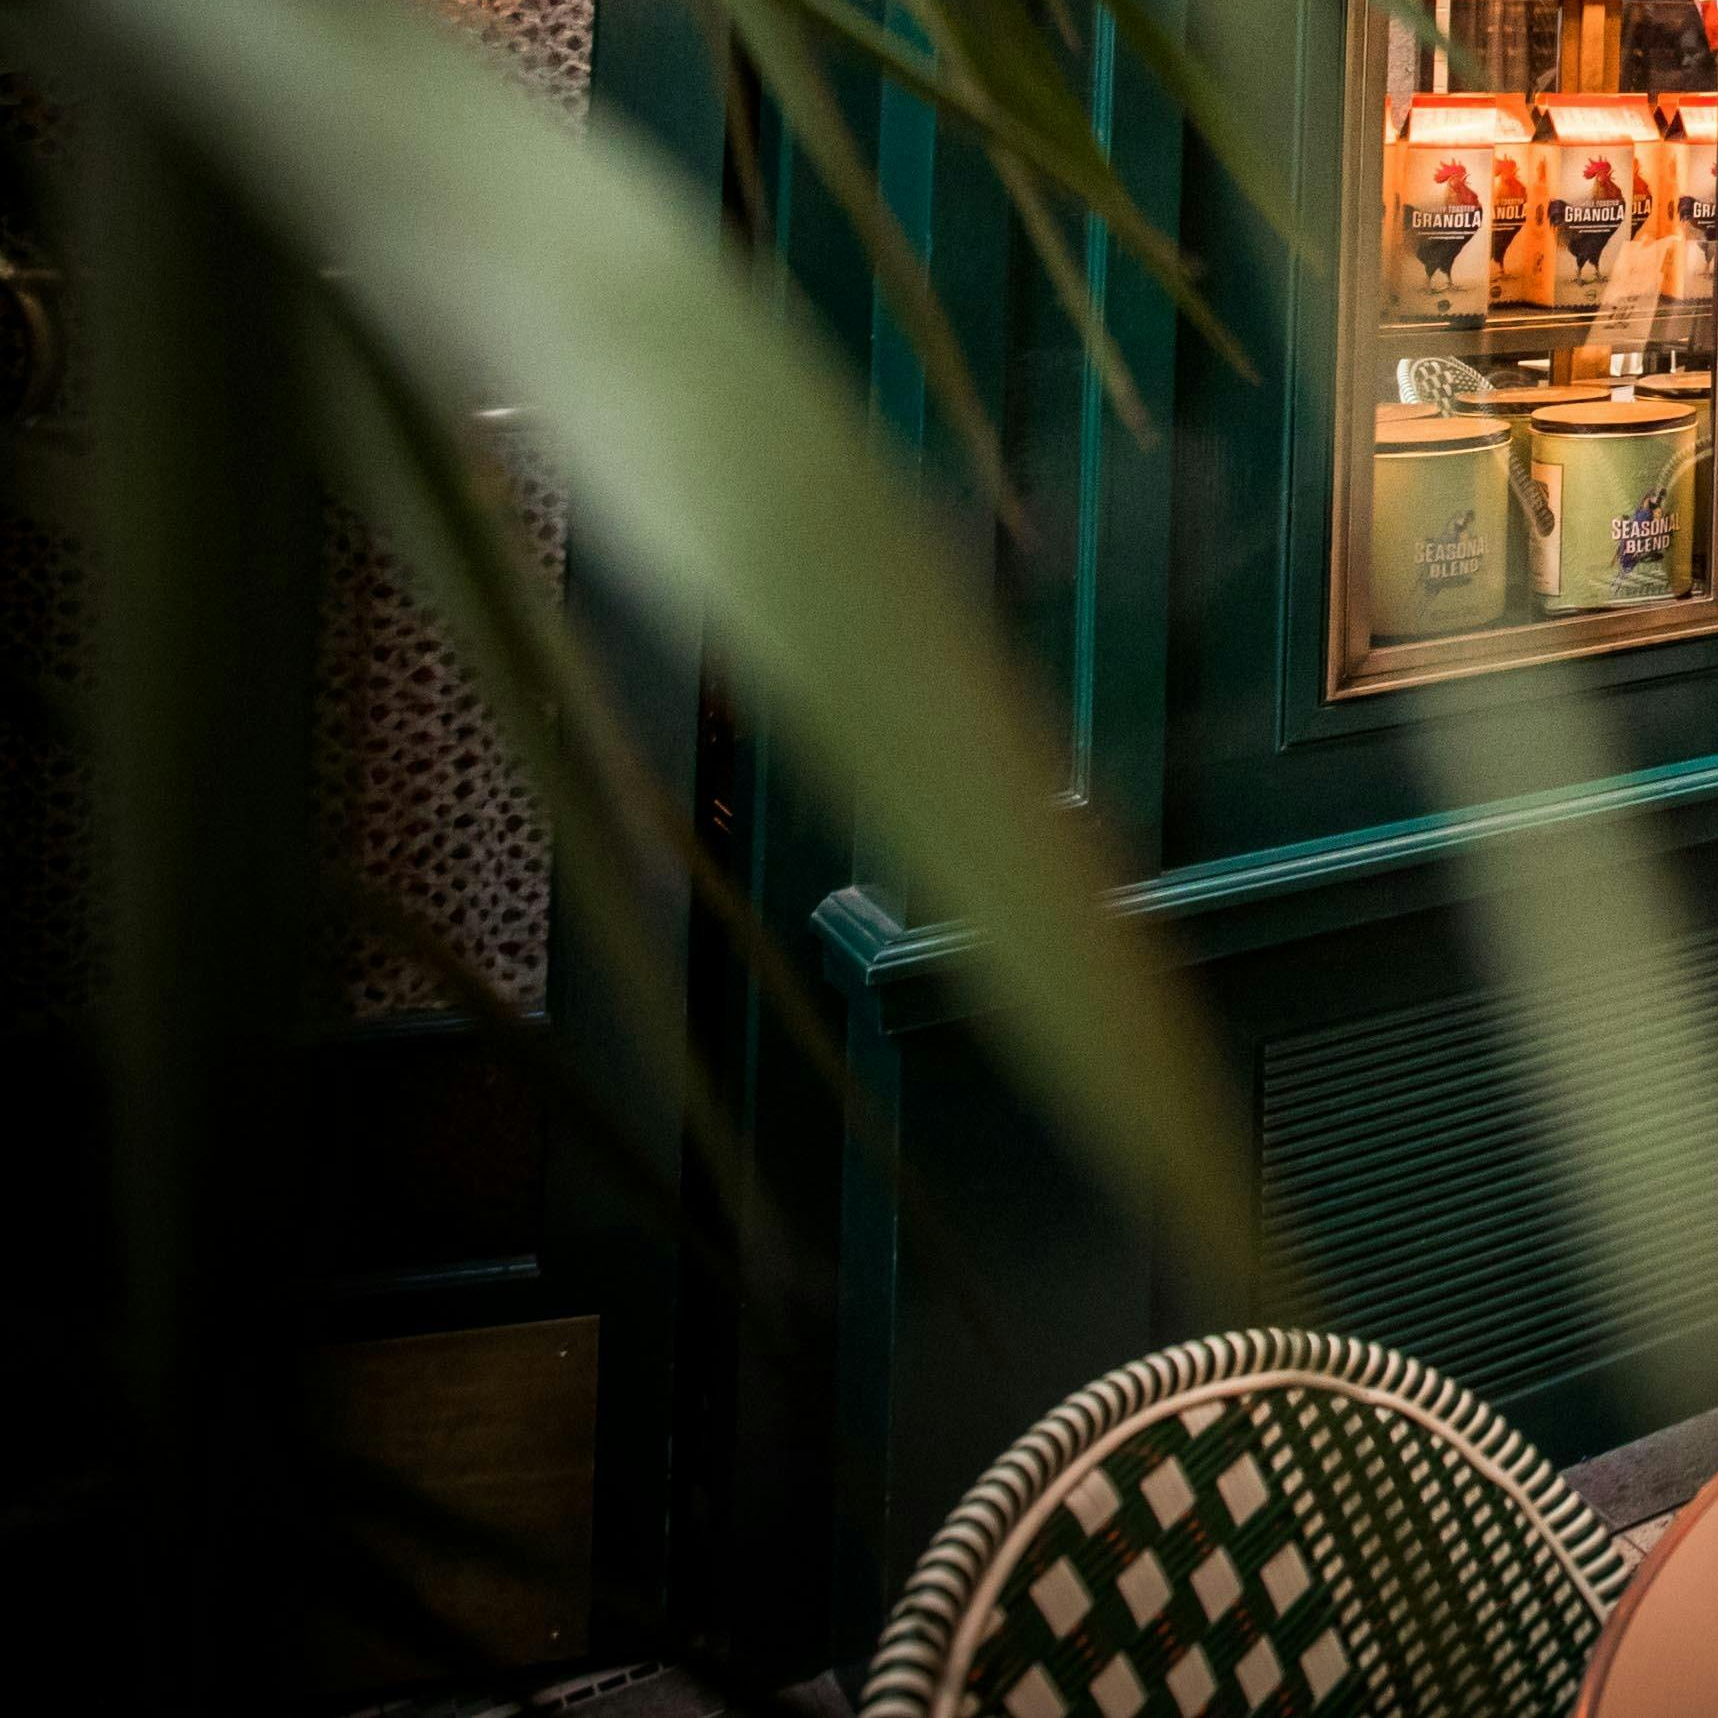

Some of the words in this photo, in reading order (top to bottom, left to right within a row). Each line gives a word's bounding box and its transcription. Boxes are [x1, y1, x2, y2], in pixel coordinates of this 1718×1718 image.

[1412, 210, 1481, 228] GRANOLA
[1564, 204, 1625, 223] GRANOLA
[1611, 512, 1682, 541] SEASONAL
[1414, 534, 1490, 565] SEASONAL
[1625, 534, 1671, 554] BLEND
[1428, 557, 1480, 578] BLEND
